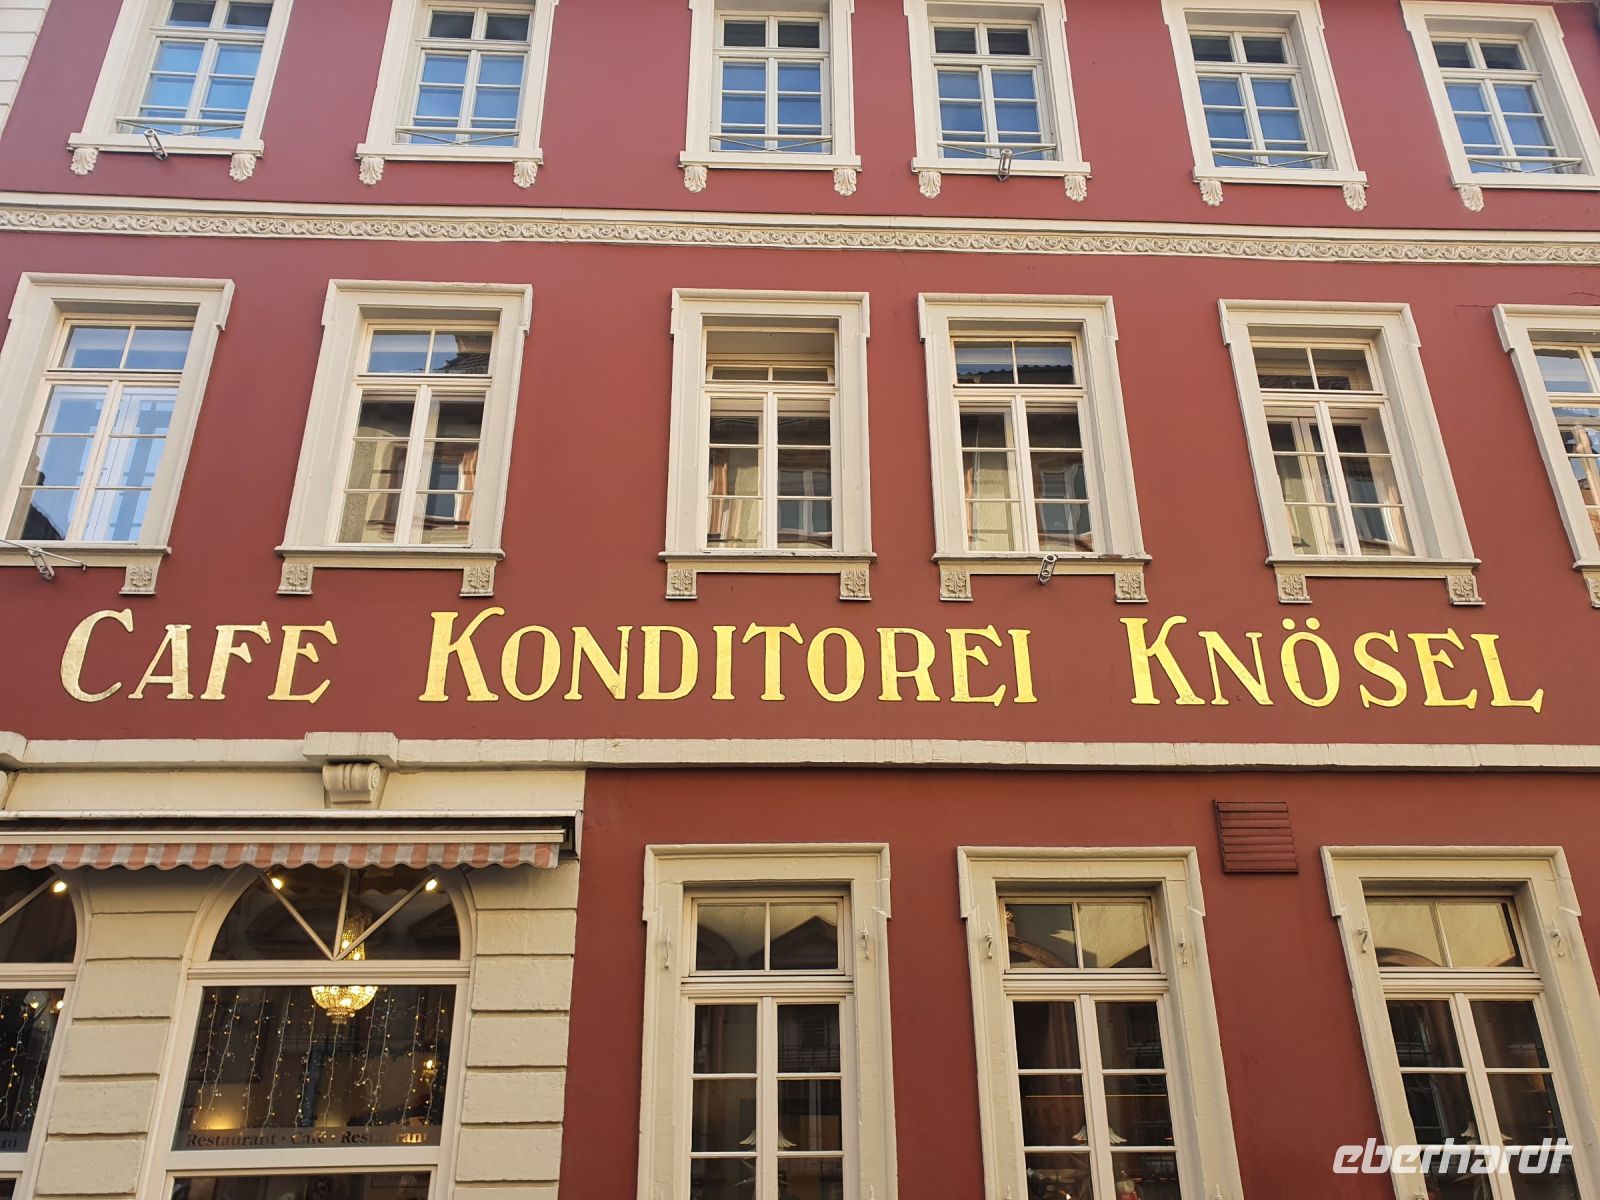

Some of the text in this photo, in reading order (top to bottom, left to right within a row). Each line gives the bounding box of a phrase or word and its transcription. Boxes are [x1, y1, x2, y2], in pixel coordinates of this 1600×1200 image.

[60, 606, 1545, 714] CAFE KONDITOREI KNÖSEL
[186, 1131, 276, 1147] Restaurant
[340, 1129, 429, 1145] Restrant
